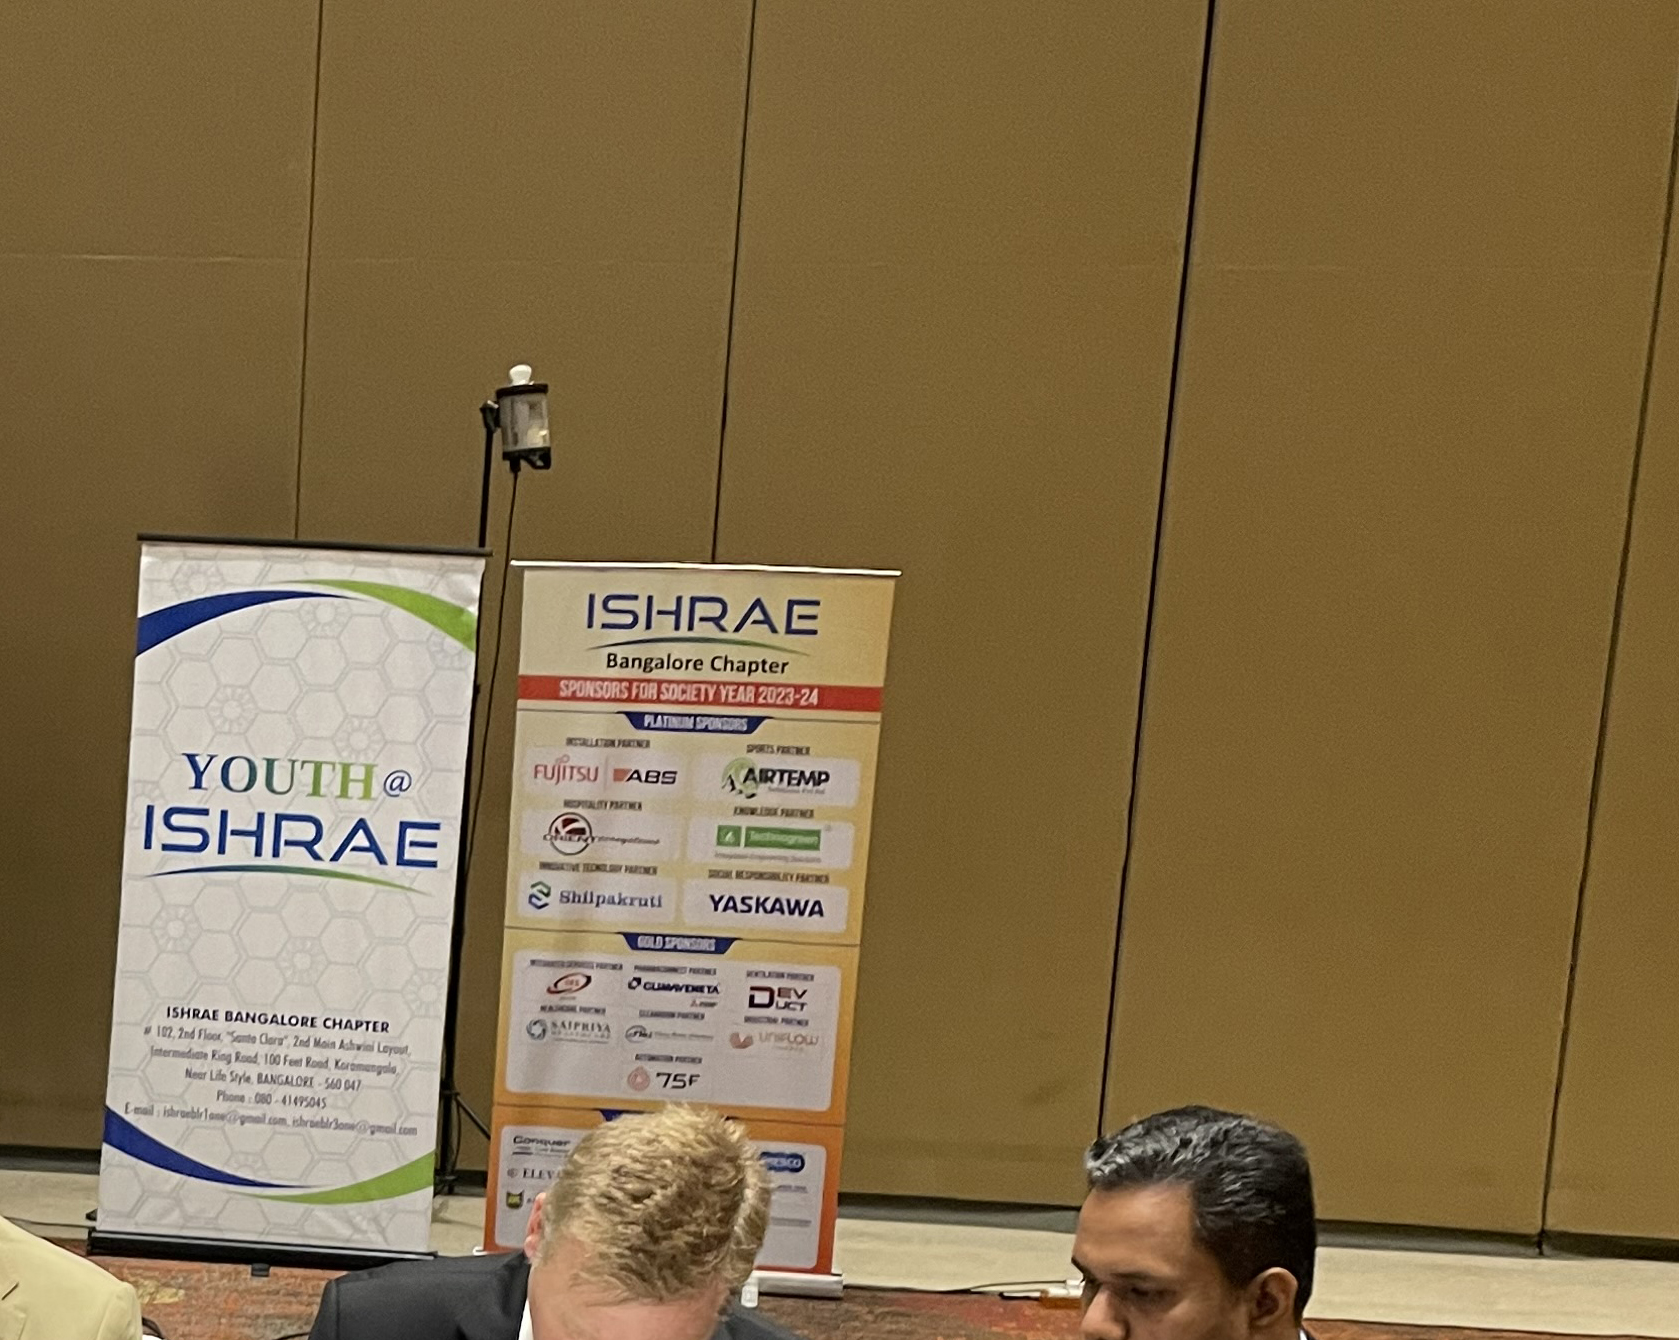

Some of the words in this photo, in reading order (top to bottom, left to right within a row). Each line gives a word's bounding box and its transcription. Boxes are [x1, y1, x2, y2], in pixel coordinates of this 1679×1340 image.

[586, 593, 821, 636] ISHRAE
[606, 653, 703, 673] Bangalore
[710, 655, 789, 677] Chapter
[559, 680, 629, 699] SPONSORS
[631, 682, 657, 700] FOR
[659, 683, 717, 702] SOCIETY
[720, 684, 755, 703] YEAR
[758, 687, 819, 706] 2023-24
[643, 714, 694, 729] PLATINUM
[696, 716, 748, 731] SPONSORS
[181, 752, 378, 801] YOUTH
[383, 770, 412, 797] @
[534, 758, 599, 785] FUJITSU
[625, 769, 678, 785] ABS
[742, 767, 831, 787] AIRTEMP
[143, 804, 442, 868] ISHRAE
[559, 890, 663, 908] Shilpakruti
[709, 894, 825, 918] YASKAWA
[637, 935, 663, 949] GOLD
[167, 1006, 219, 1021] ISHRAE
[225, 1010, 318, 1028] BANGALORE
[323, 1017, 390, 1033] CHAPTER
[178, 1027, 195, 1040] 2nd
[293, 1035, 310, 1048] 2nd
[313, 1037, 336, 1050] Main
[339, 1039, 374, 1052] Ashwini
[377, 1042, 412, 1057] Layout,
[151, 1045, 208, 1061] Intermediate
[212, 1049, 232, 1065] Ring
[264, 1052, 281, 1066] 100
[283, 1054, 303, 1067] Feet
[185, 1067, 207, 1080] Near
[210, 1069, 227, 1082] Life
[257, 1072, 314, 1088] BANGALORE
[325, 1077, 342, 1090] 560
[344, 1079, 362, 1092] 047
[656, 1072, 700, 1089] 75F
[124, 1102, 154, 1115] E-mail
[216, 1090, 245, 1103] Phone
[255, 1092, 272, 1105] 080
[281, 1094, 327, 1110] 41495045
